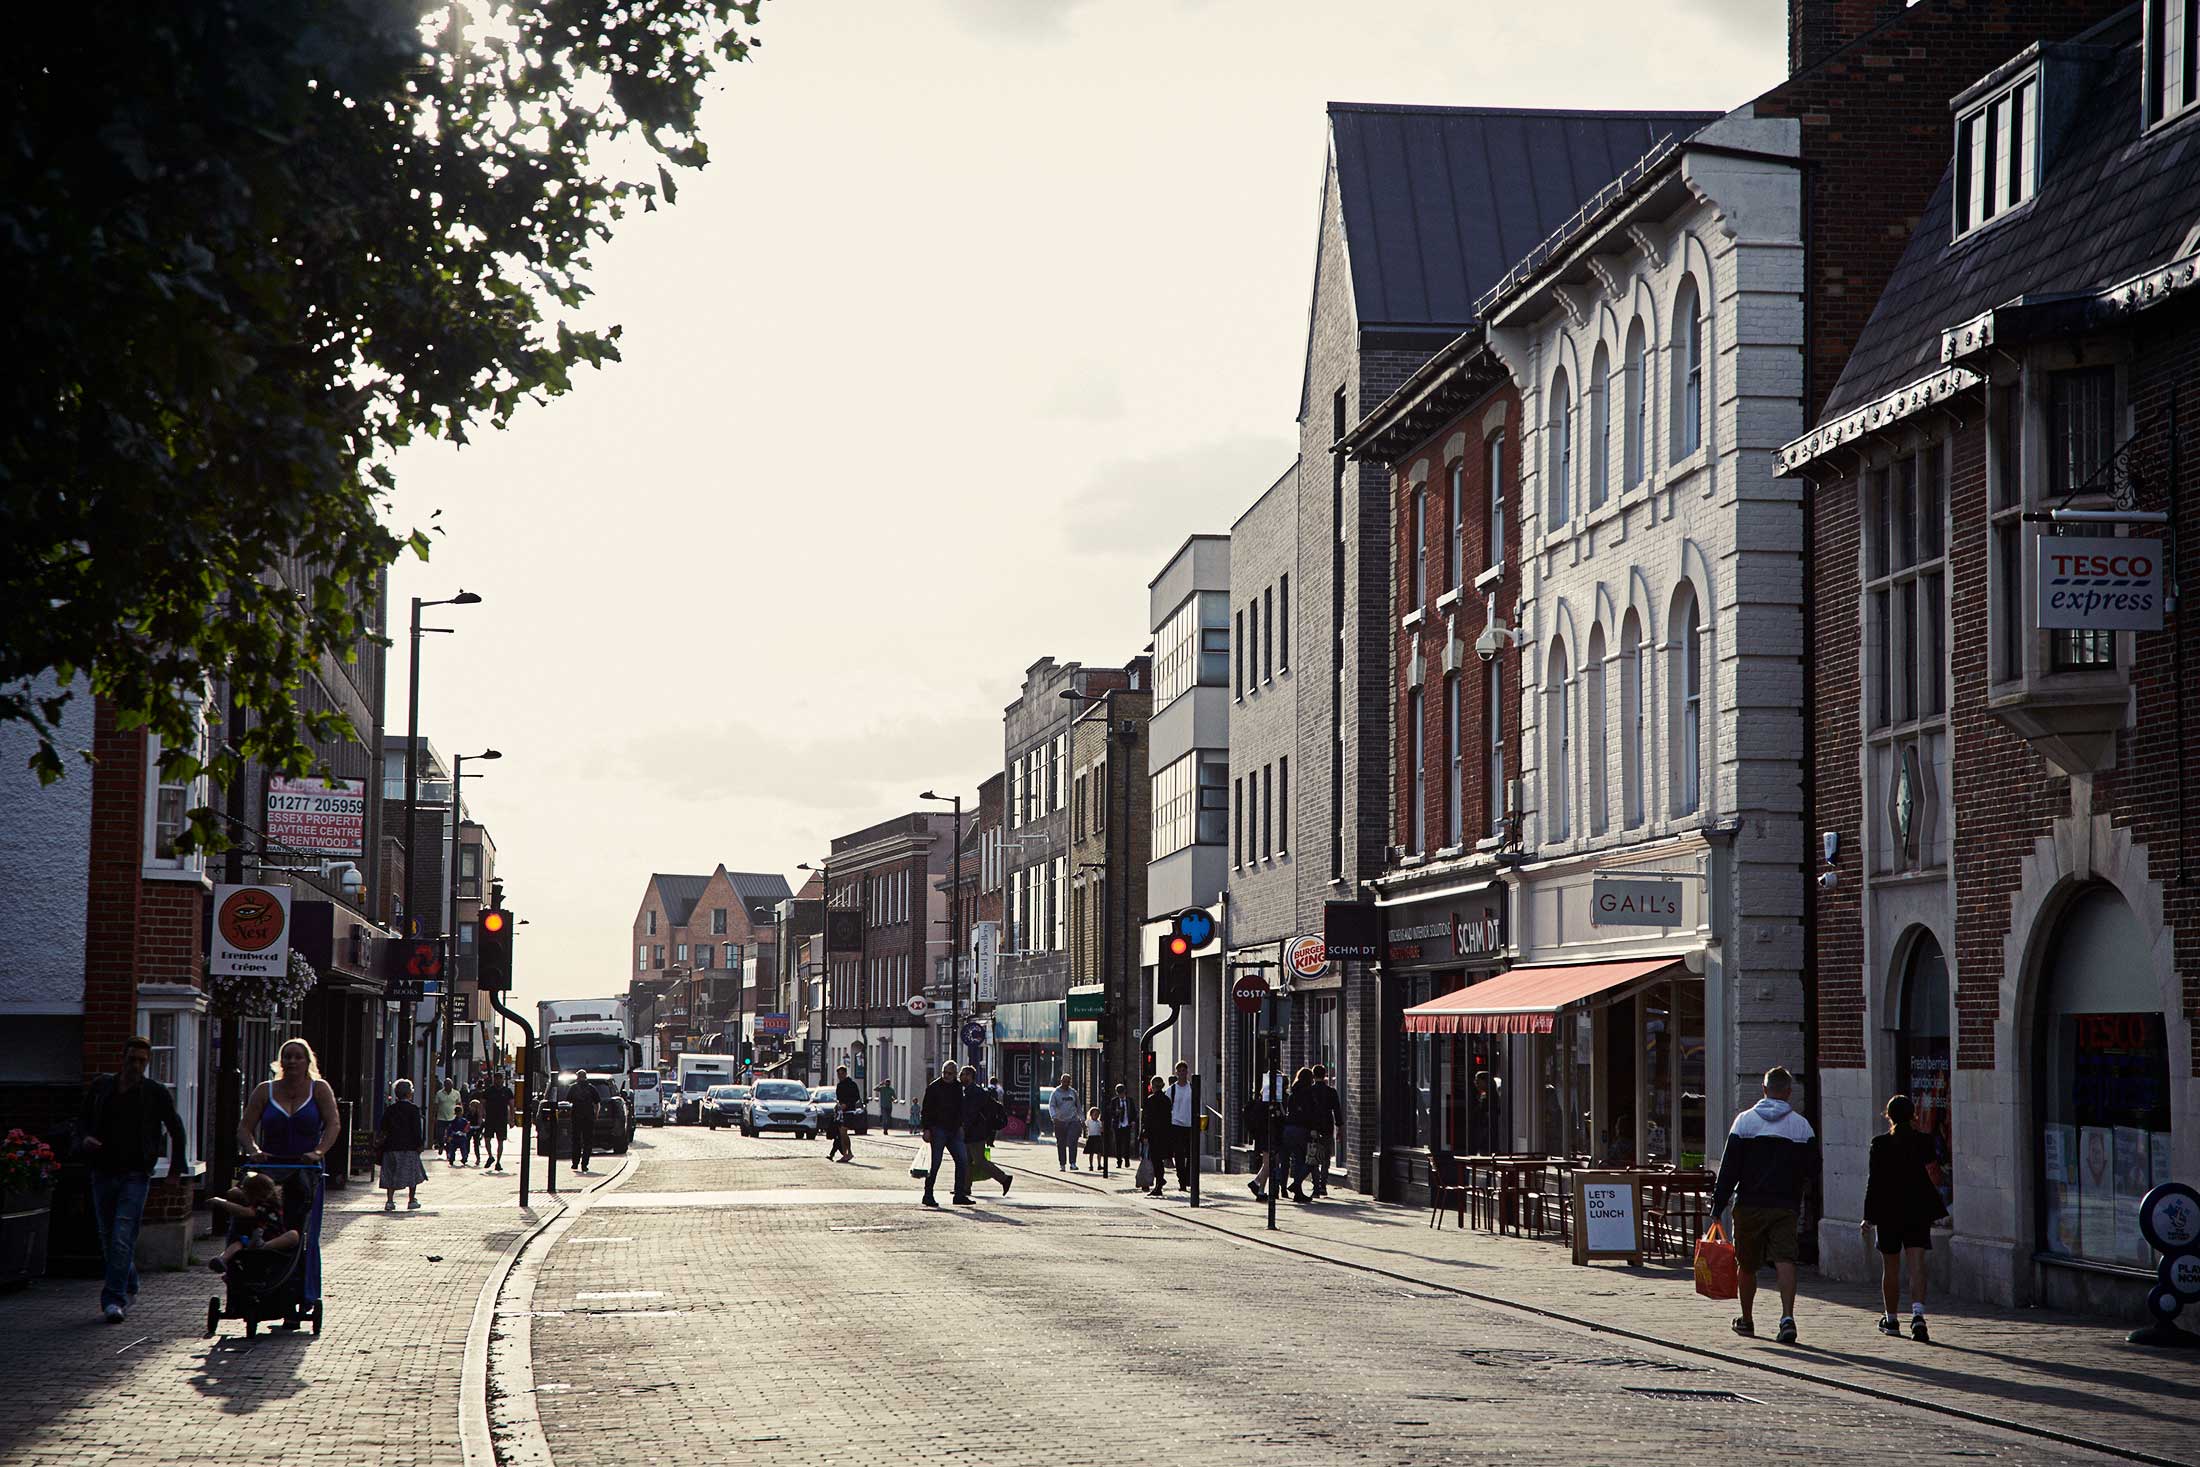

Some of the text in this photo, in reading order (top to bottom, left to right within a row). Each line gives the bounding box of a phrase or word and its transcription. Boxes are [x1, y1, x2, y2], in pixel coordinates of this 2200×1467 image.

[2051, 555, 2152, 577] TESCO
[2052, 590, 2152, 616] express
[269, 795, 364, 813] 01277 205959
[267, 812, 363, 826] ESSEX PROPERTY
[268, 823, 361, 838] BAYTREE CENTRE
[281, 835, 348, 848] BRENTWOOD
[1600, 894, 1675, 914] GAIL's
[1457, 908, 1500, 955] SCHMIDT
[221, 951, 278, 961] Brentwood
[1328, 944, 1377, 956] SCHMIDT
[231, 962, 267, 971] Crêpes
[1295, 951, 1326, 970] KING
[1588, 1190, 1616, 1199] LET'S
[1589, 1200, 1605, 1209] DO
[1590, 1209, 1625, 1219] LUNCH
